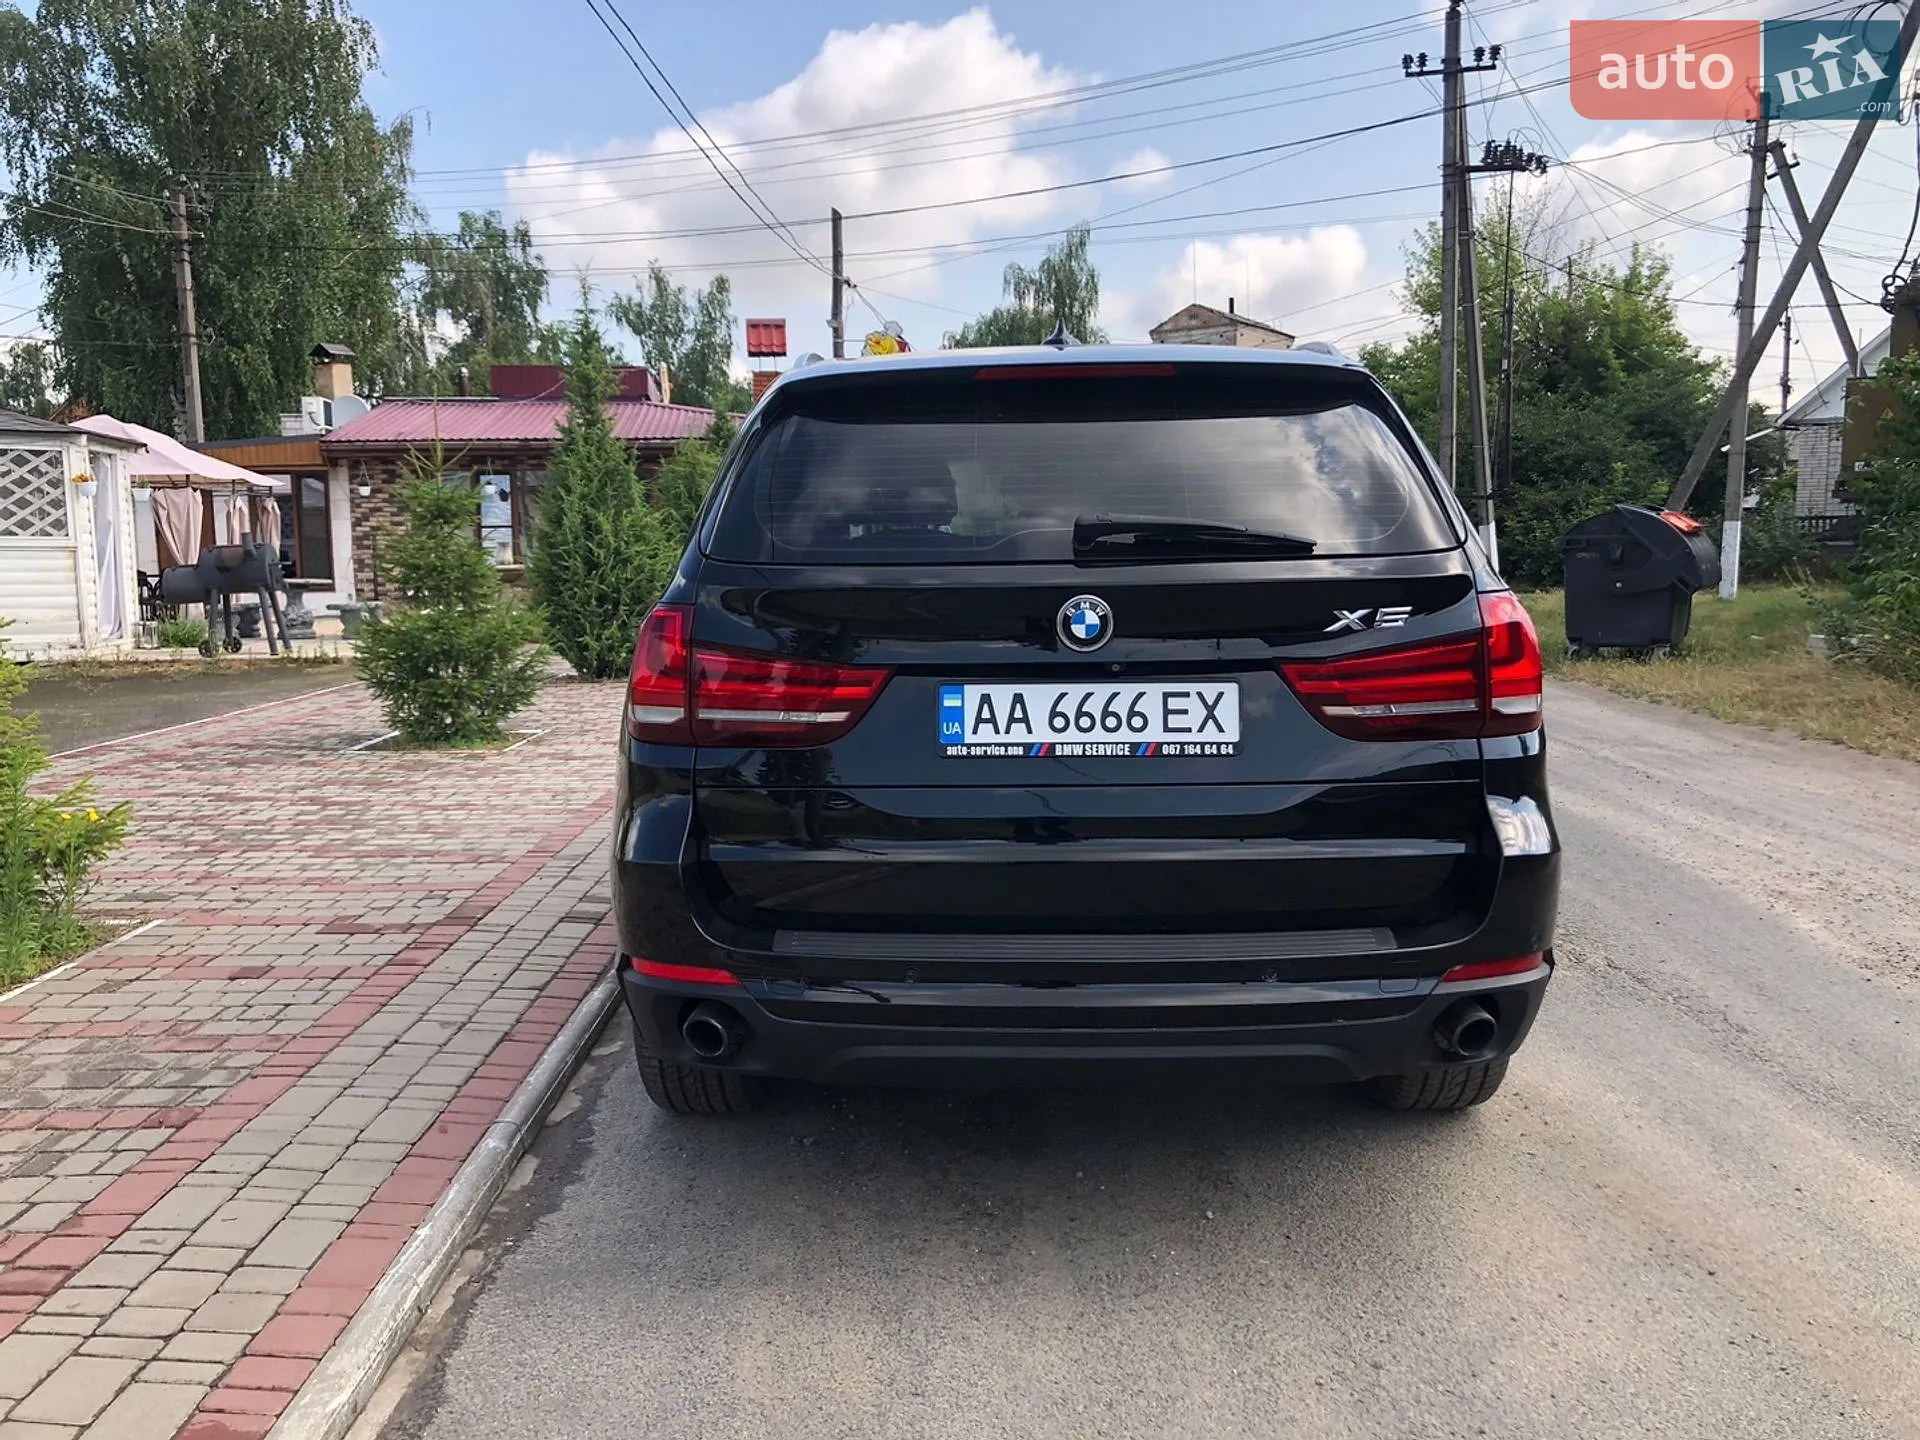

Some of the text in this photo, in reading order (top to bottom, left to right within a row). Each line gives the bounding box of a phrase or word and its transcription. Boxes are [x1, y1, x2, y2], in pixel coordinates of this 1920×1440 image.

[1065, 601, 1106, 617] BMW
[1322, 606, 1413, 632] X5
[971, 691, 1226, 735] AA 6666 EX
[943, 724, 962, 735] UA
[1055, 743, 1084, 756] BMW
[1084, 743, 1131, 756] SERVICE
[1162, 744, 1180, 755] 067
[1183, 744, 1201, 755] 164
[1204, 744, 1217, 755] 64
[1220, 744, 1234, 755] 64
